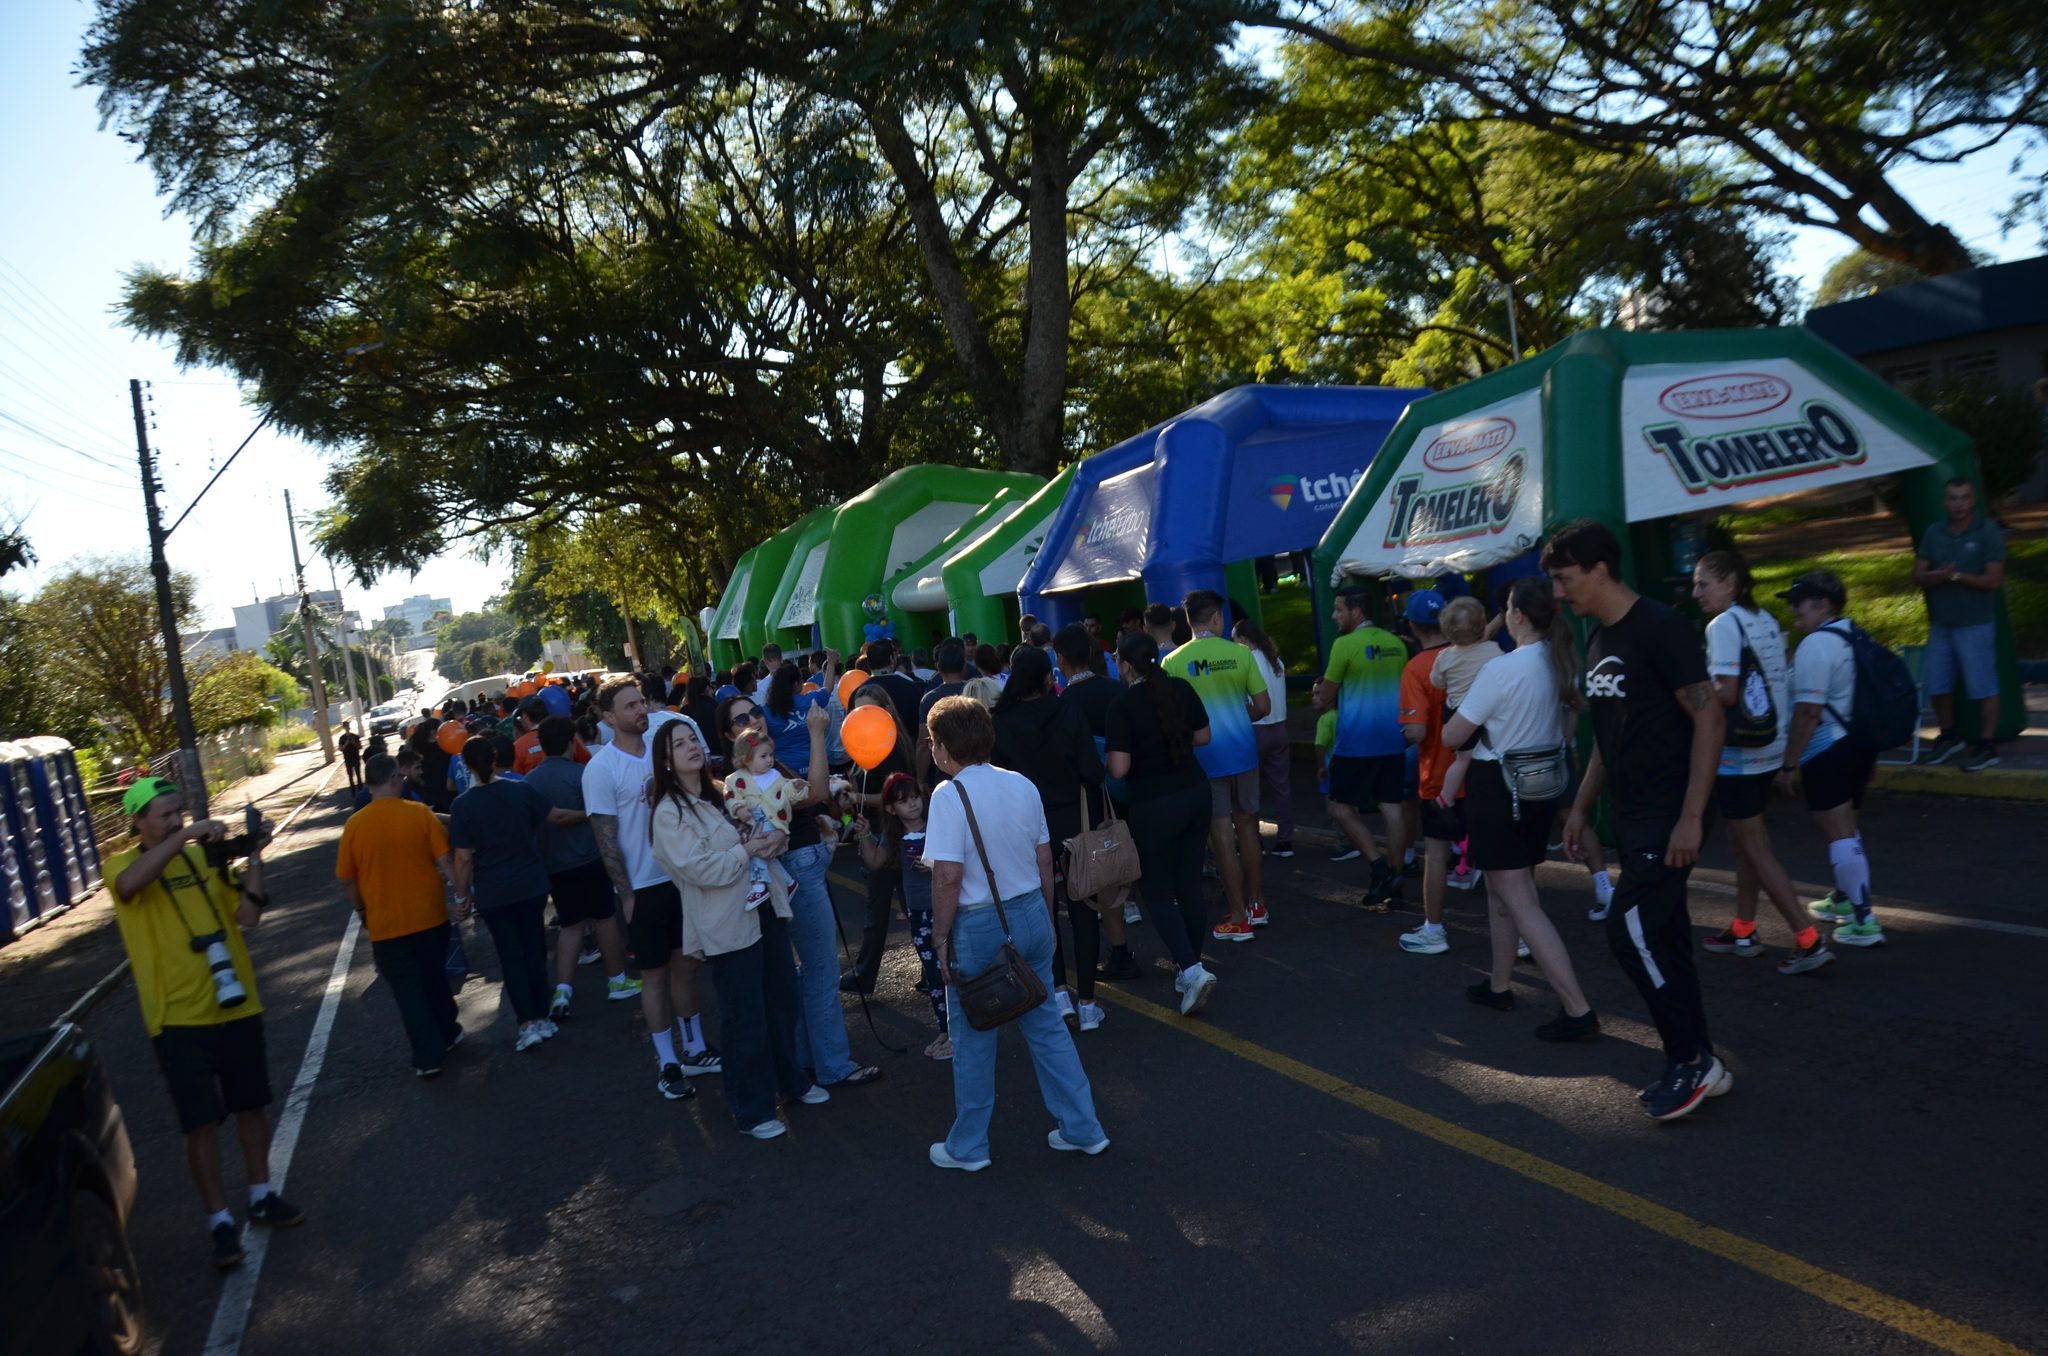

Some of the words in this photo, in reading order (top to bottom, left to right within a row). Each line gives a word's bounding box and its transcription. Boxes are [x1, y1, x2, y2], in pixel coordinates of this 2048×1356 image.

[1672, 380, 1780, 411] ERVA-MATE
[1432, 425, 1507, 462] ERVA-MATE
[1646, 402, 1863, 488] TOMELERO
[1387, 450, 1525, 542] TOMELERO
